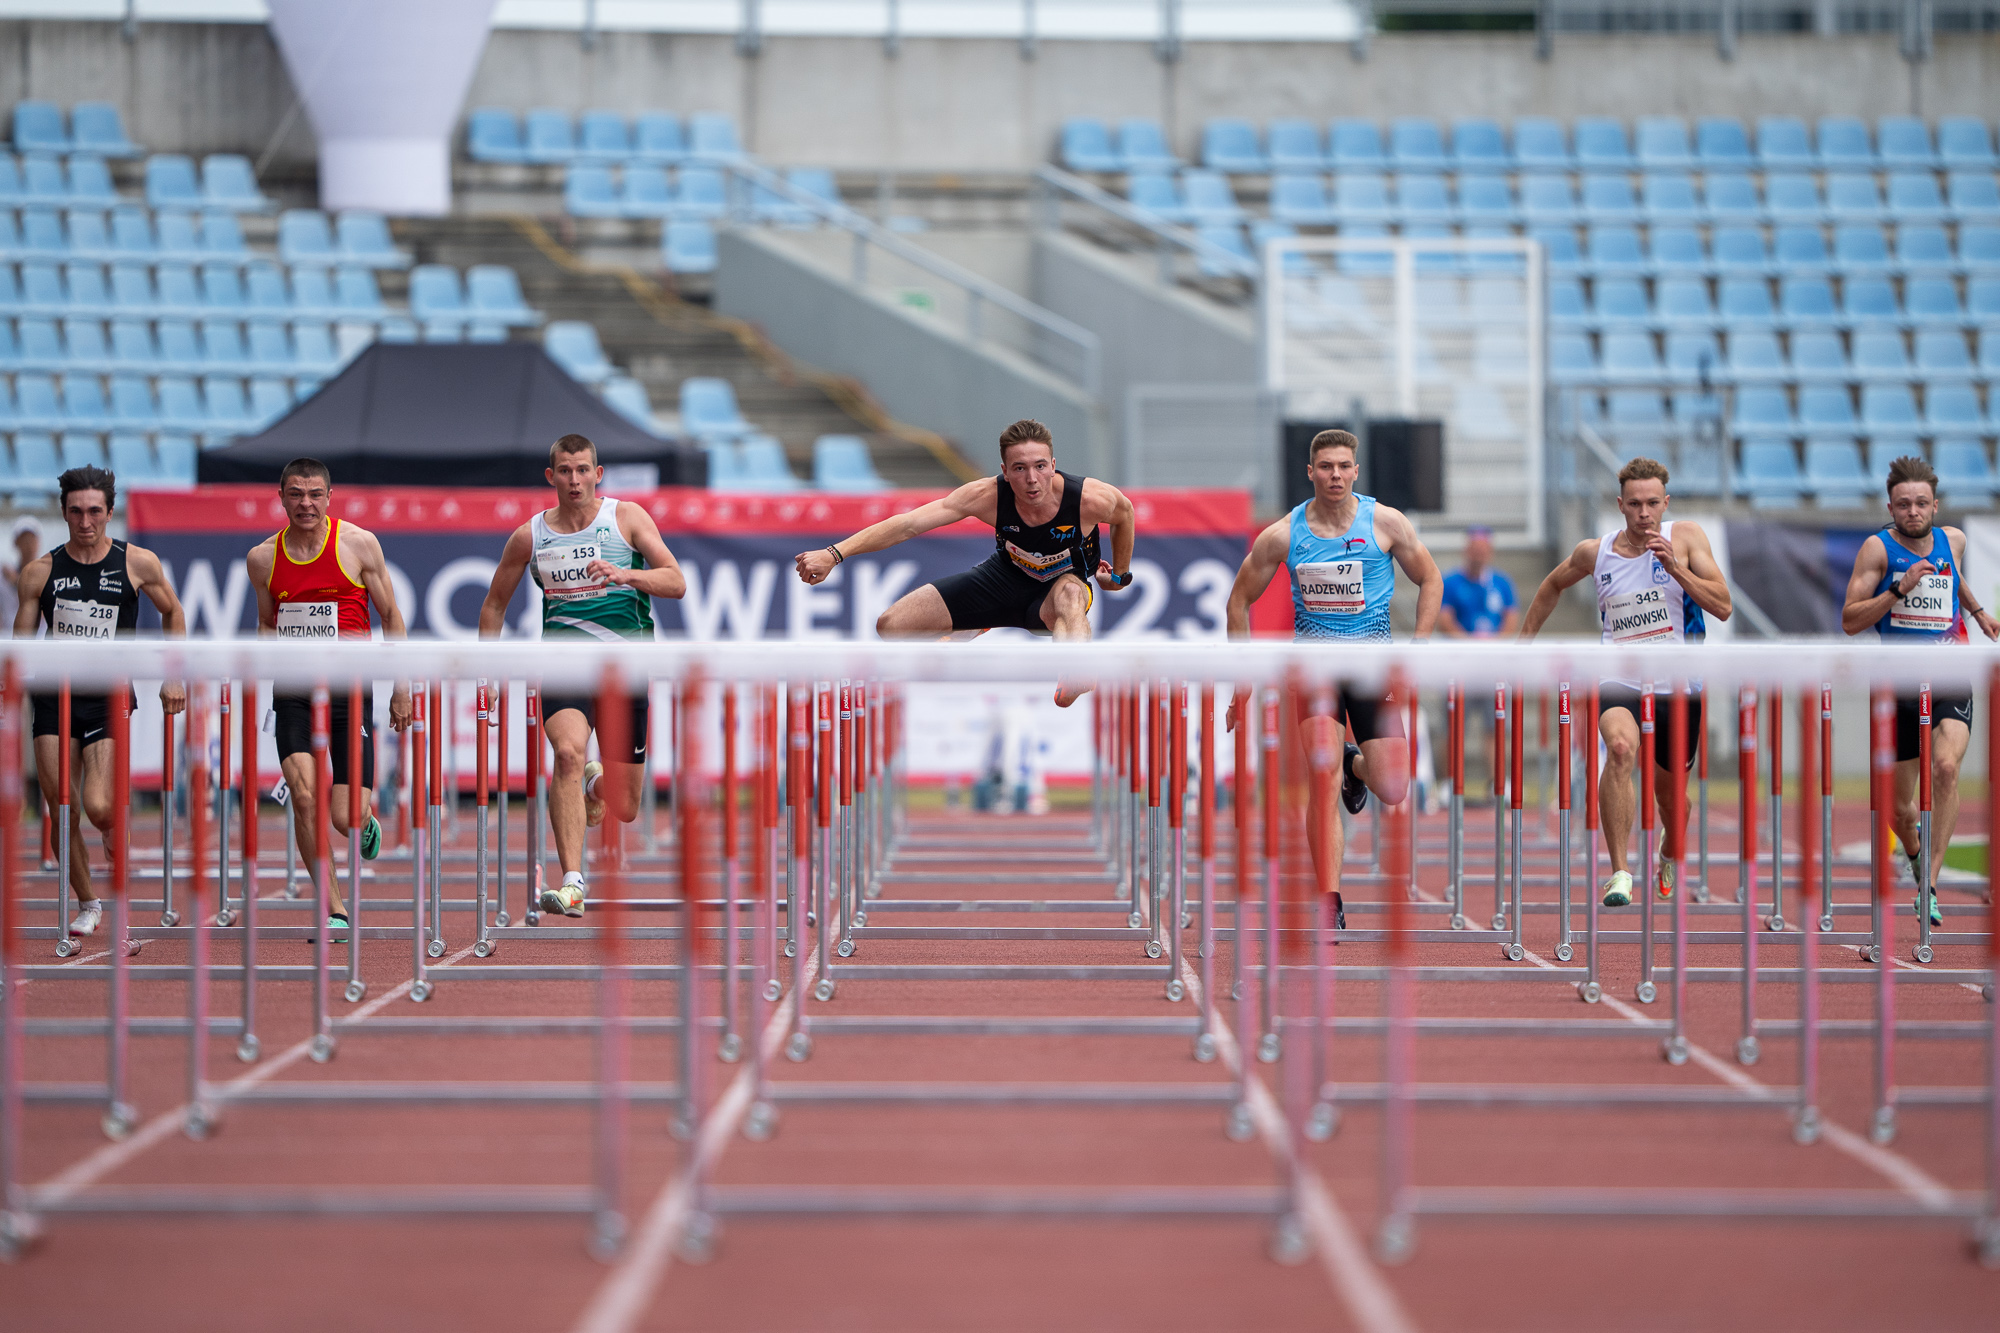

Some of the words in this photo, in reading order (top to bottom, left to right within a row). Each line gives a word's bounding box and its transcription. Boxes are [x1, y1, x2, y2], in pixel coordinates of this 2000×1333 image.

[1050, 526, 1076, 542] Sopot
[572, 546, 595, 559] 153
[1040, 553, 1065, 565] 288
[1337, 563, 1353, 575] 97
[1300, 582, 1362, 595] RADZEWICZ
[1929, 578, 1948, 589] 388
[1635, 590, 1659, 605] 343
[1904, 595, 1942, 610] ŁOSIN
[89, 606, 113, 619] 218
[309, 605, 332, 617] 248
[1612, 607, 1668, 632] JANKOWSKI
[57, 621, 110, 639] BABULA
[278, 625, 336, 638] MIEZIANKO
[278, 781, 289, 799] 5
